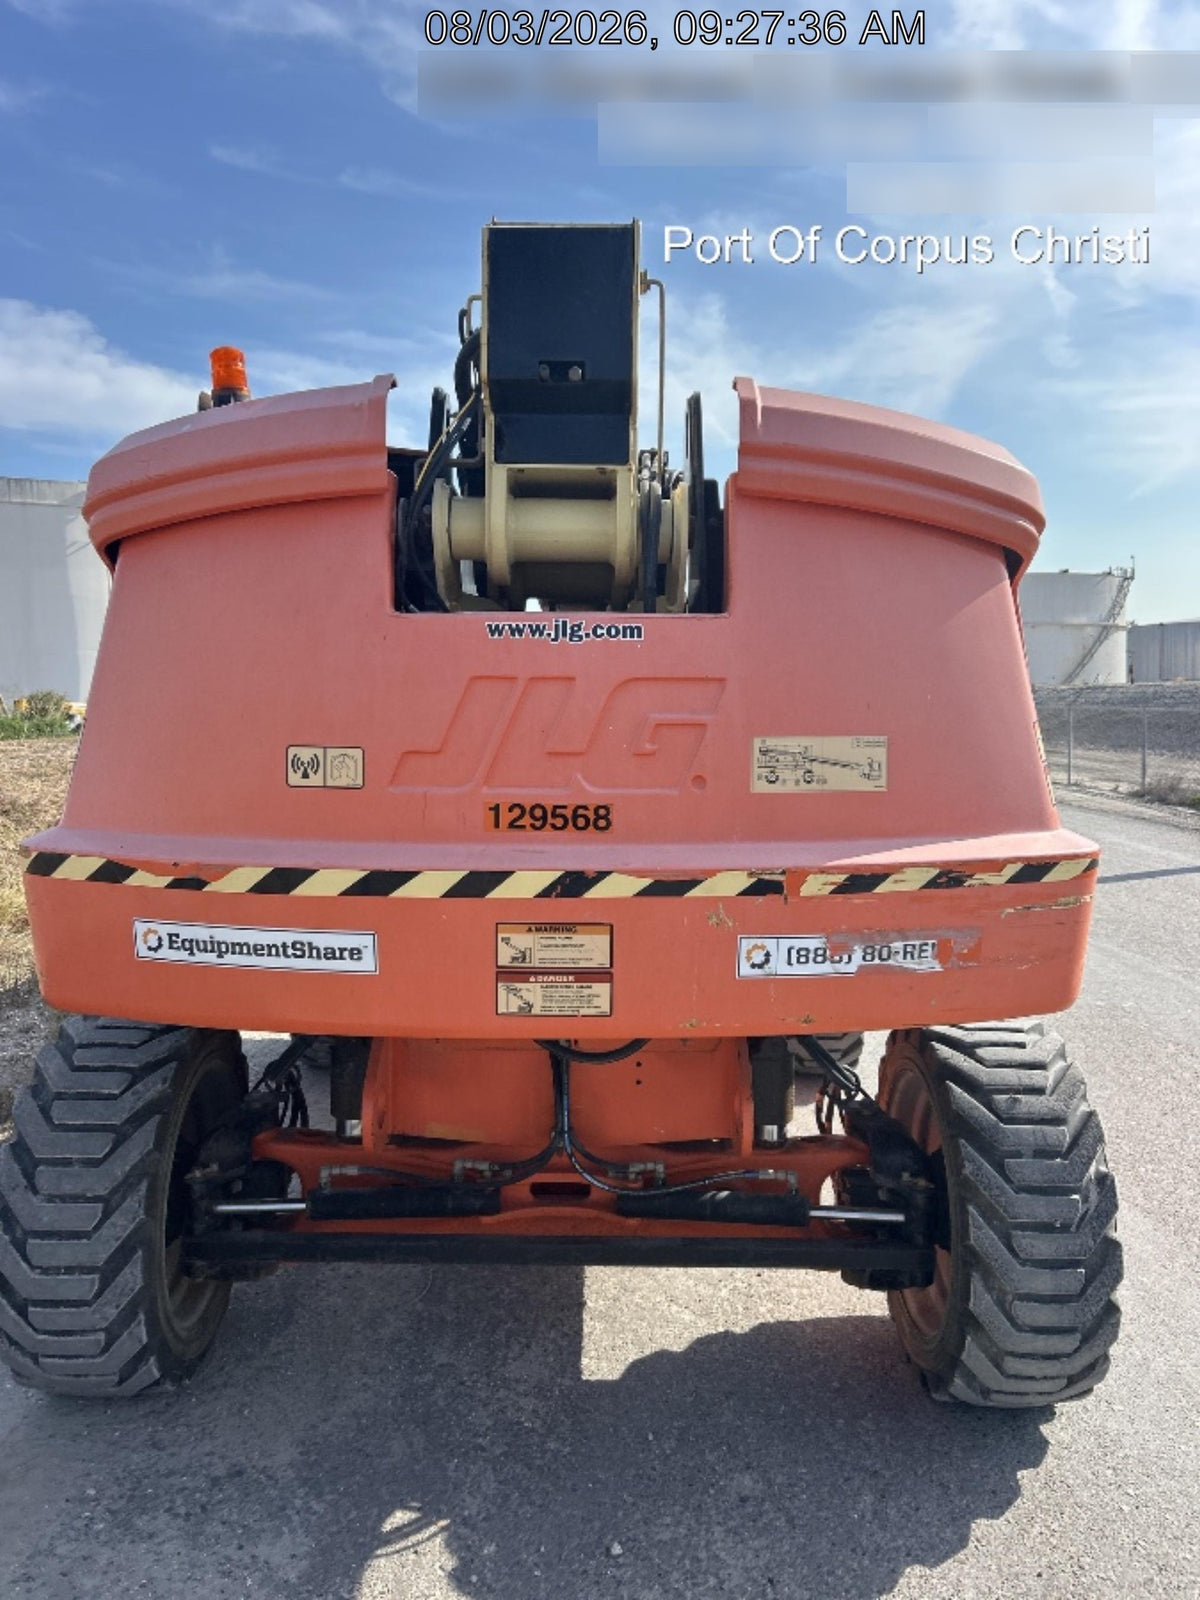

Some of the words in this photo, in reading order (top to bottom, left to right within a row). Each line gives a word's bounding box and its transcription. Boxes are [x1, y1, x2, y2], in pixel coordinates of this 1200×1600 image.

[486, 619, 644, 644] www.jlg.com
[388, 676, 728, 795] JLG
[487, 802, 613, 832] 129568
[534, 925, 578, 935] WARNING
[166, 932, 363, 962] EquipmentShare
